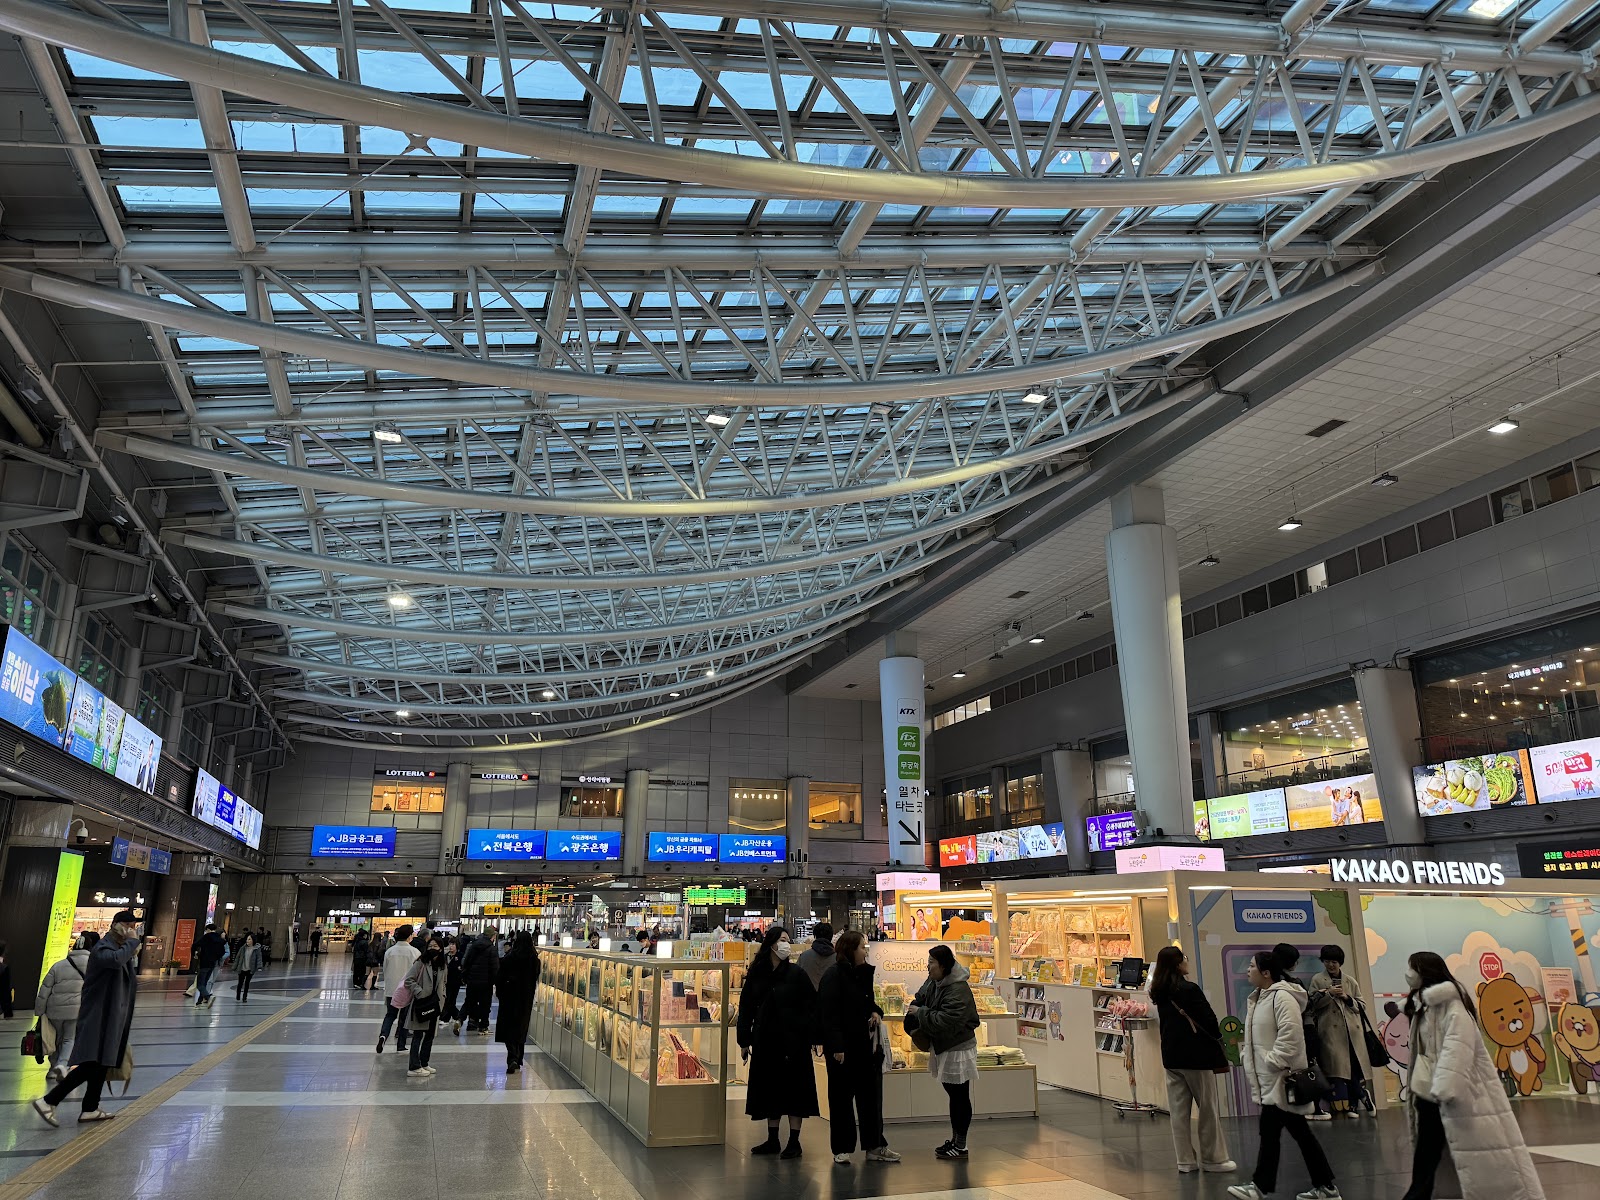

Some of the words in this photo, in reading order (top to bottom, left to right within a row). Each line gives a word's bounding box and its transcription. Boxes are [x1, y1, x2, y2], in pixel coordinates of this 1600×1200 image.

[900, 761, 919, 770] 무궁화
[1564, 757, 1589, 770] 반값
[386, 769, 425, 777] LOTTERIA
[895, 801, 914, 812] 타는
[916, 802, 923, 813] 곳
[337, 833, 383, 844] JB금융그룹
[740, 839, 773, 847] JB자산운용
[492, 841, 533, 853] 전북은행
[570, 842, 609, 854] 광주은행
[664, 845, 713, 855] JB우리캐피탈
[1543, 851, 1563, 860] 안전한
[1330, 858, 1410, 883] KAKAO
[1412, 860, 1505, 886] FRIENDS
[1483, 963, 1499, 971] STOP
